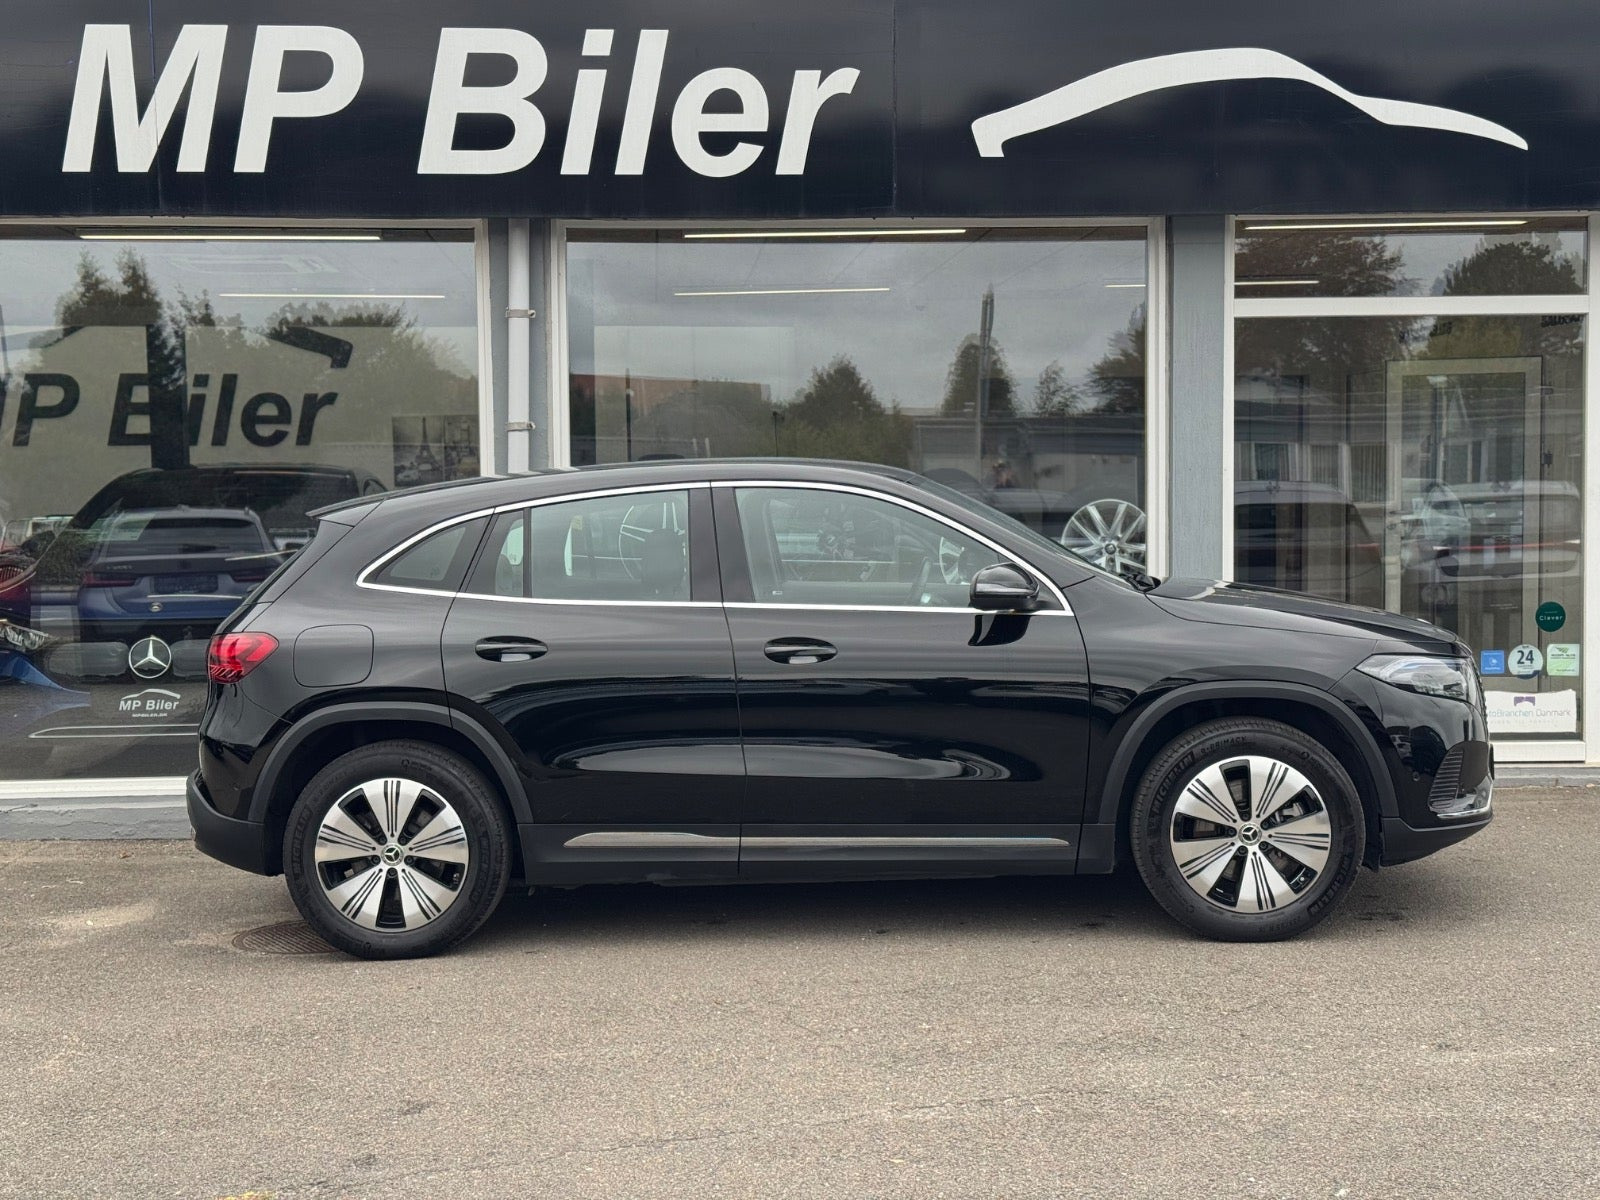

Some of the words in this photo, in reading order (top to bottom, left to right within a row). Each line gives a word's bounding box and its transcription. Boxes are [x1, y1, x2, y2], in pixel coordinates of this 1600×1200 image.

[61, 23, 366, 174] MP
[416, 27, 862, 178] Biler
[0, 372, 81, 447] P
[1517, 650, 1535, 665] 24
[118, 700, 141, 711] MP
[145, 700, 179, 711] Biler
[1488, 708, 1533, 718] toBranchen
[1535, 708, 1572, 717] Danmark
[1151, 753, 1193, 815] MICHELIN
[1308, 854, 1353, 915] MICHELIN
